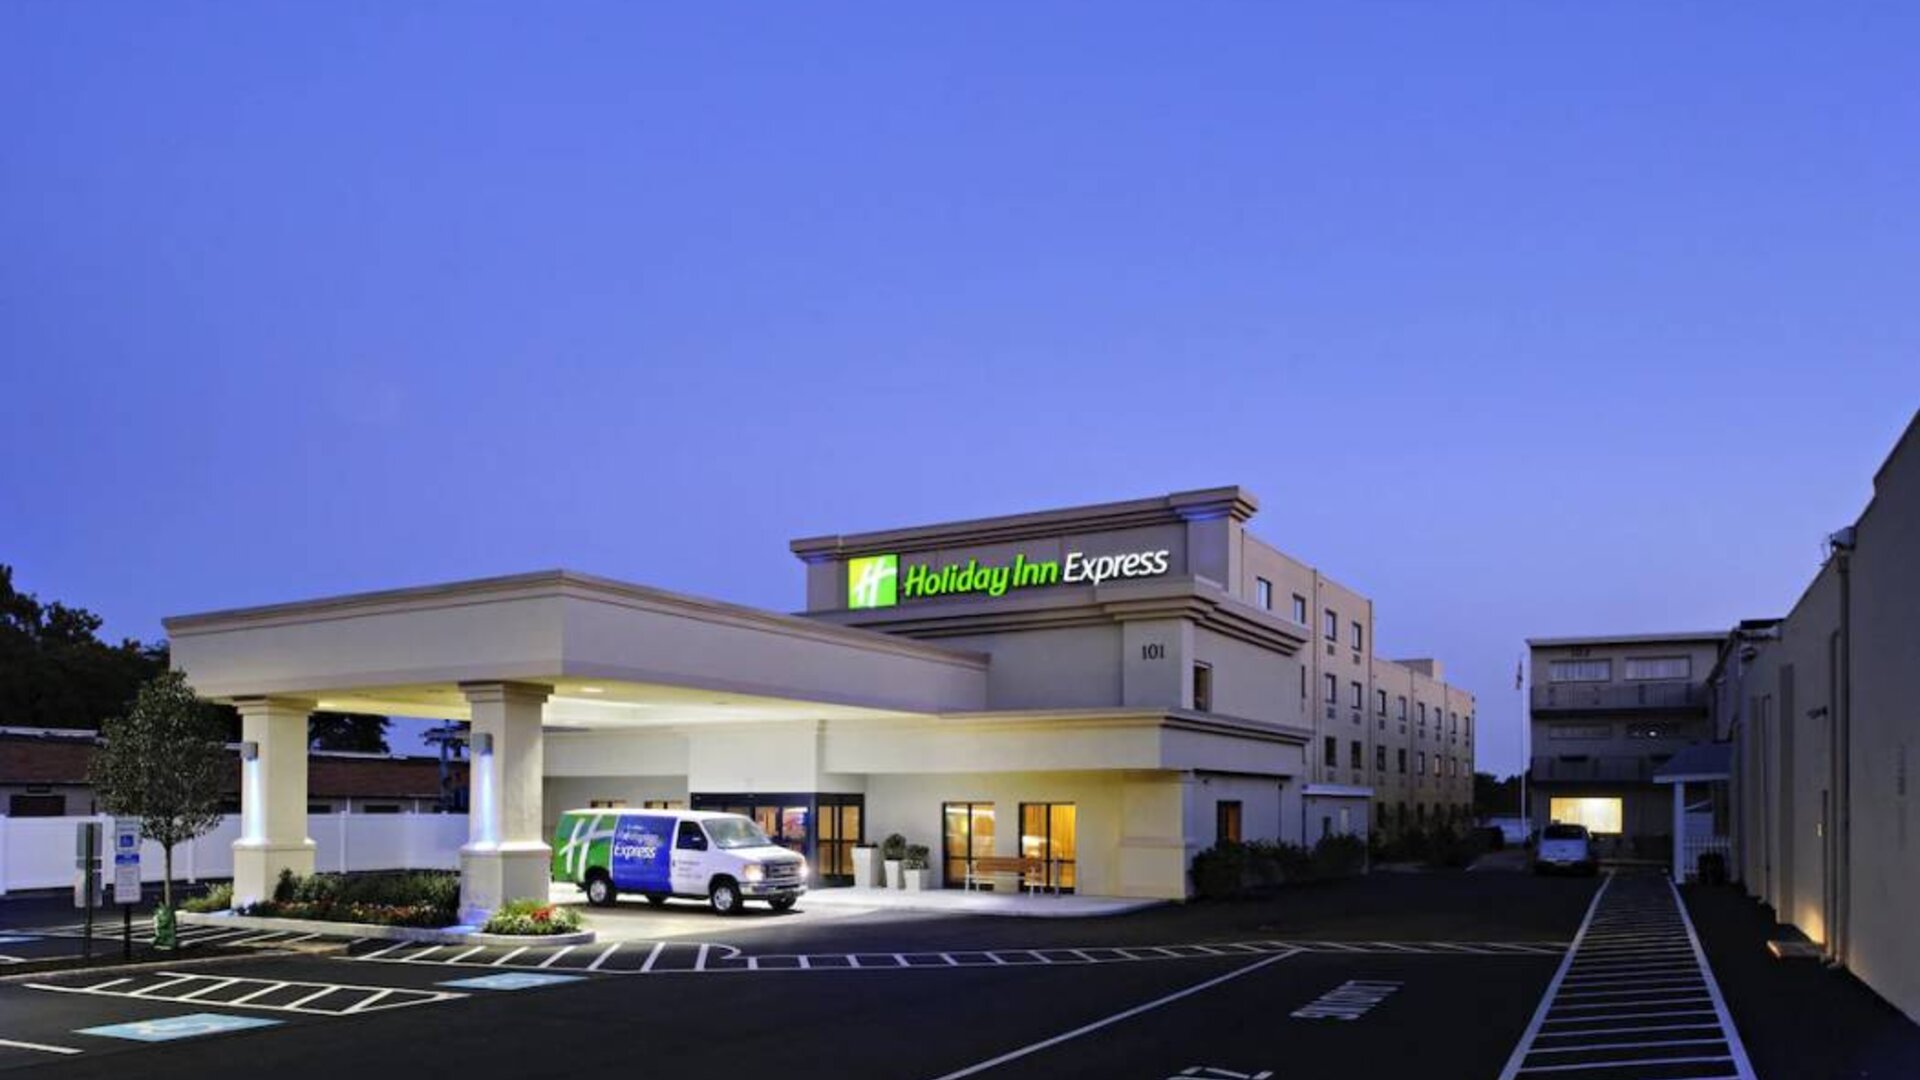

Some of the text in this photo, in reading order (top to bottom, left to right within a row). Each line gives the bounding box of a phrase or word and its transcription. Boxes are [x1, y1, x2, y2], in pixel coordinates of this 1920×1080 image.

[903, 549, 1169, 597] Holiday Inn Express
[1142, 644, 1165, 660] 101
